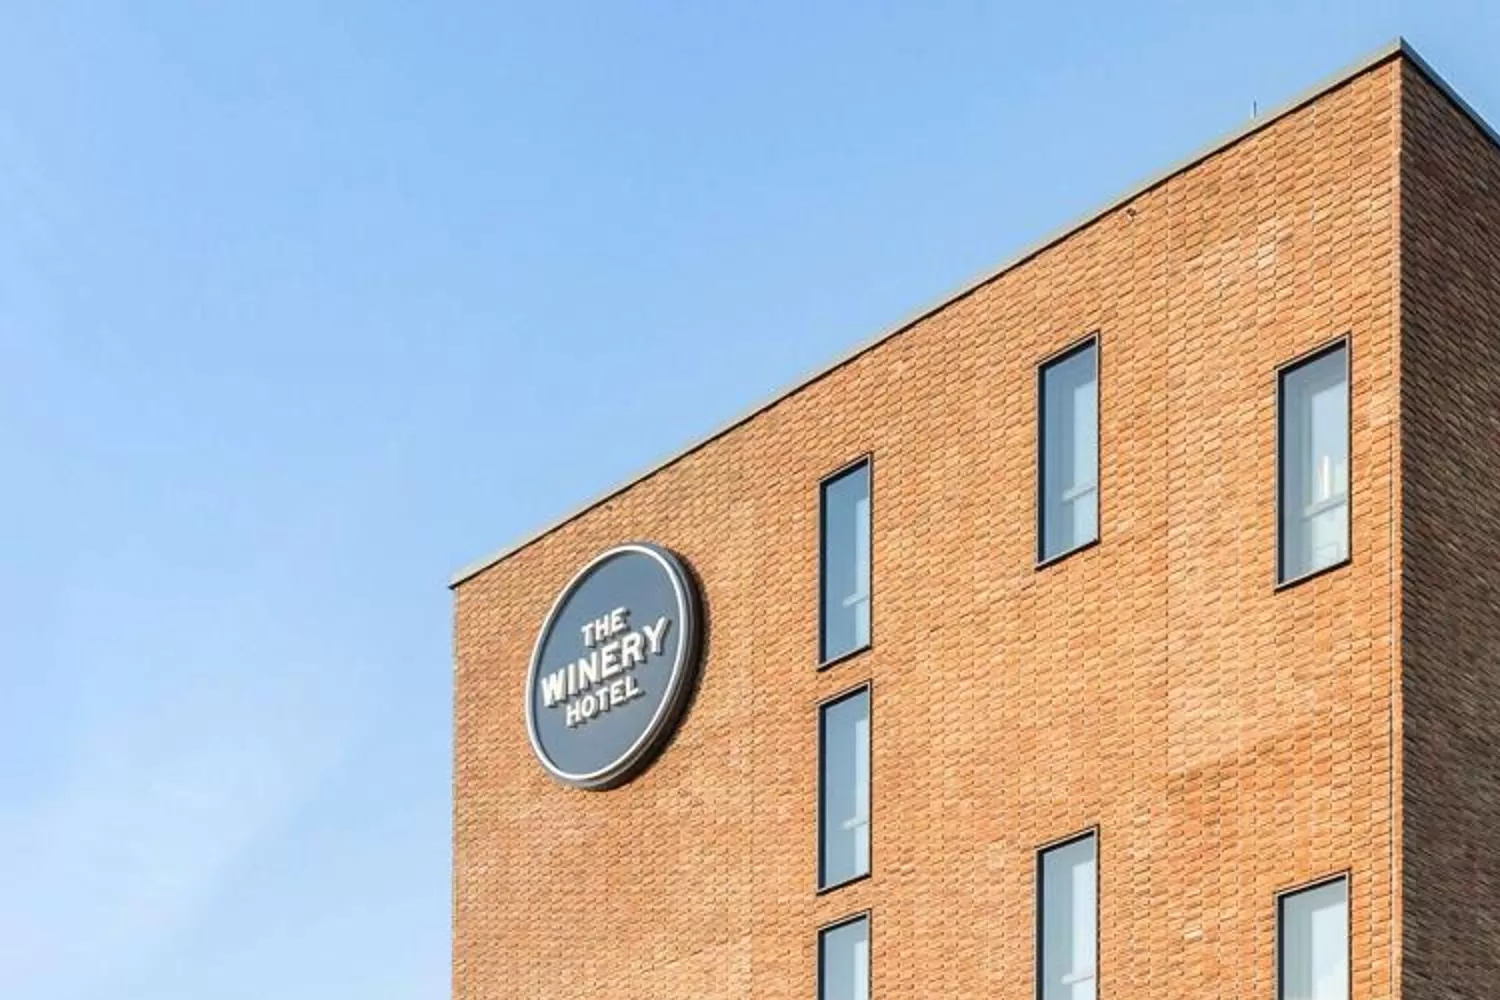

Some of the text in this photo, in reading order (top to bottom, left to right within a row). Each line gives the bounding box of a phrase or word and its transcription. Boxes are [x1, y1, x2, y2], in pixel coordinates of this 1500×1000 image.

[581, 607, 628, 648] THE
[541, 616, 669, 707] WINERY
[565, 676, 640, 727] HOTEL
